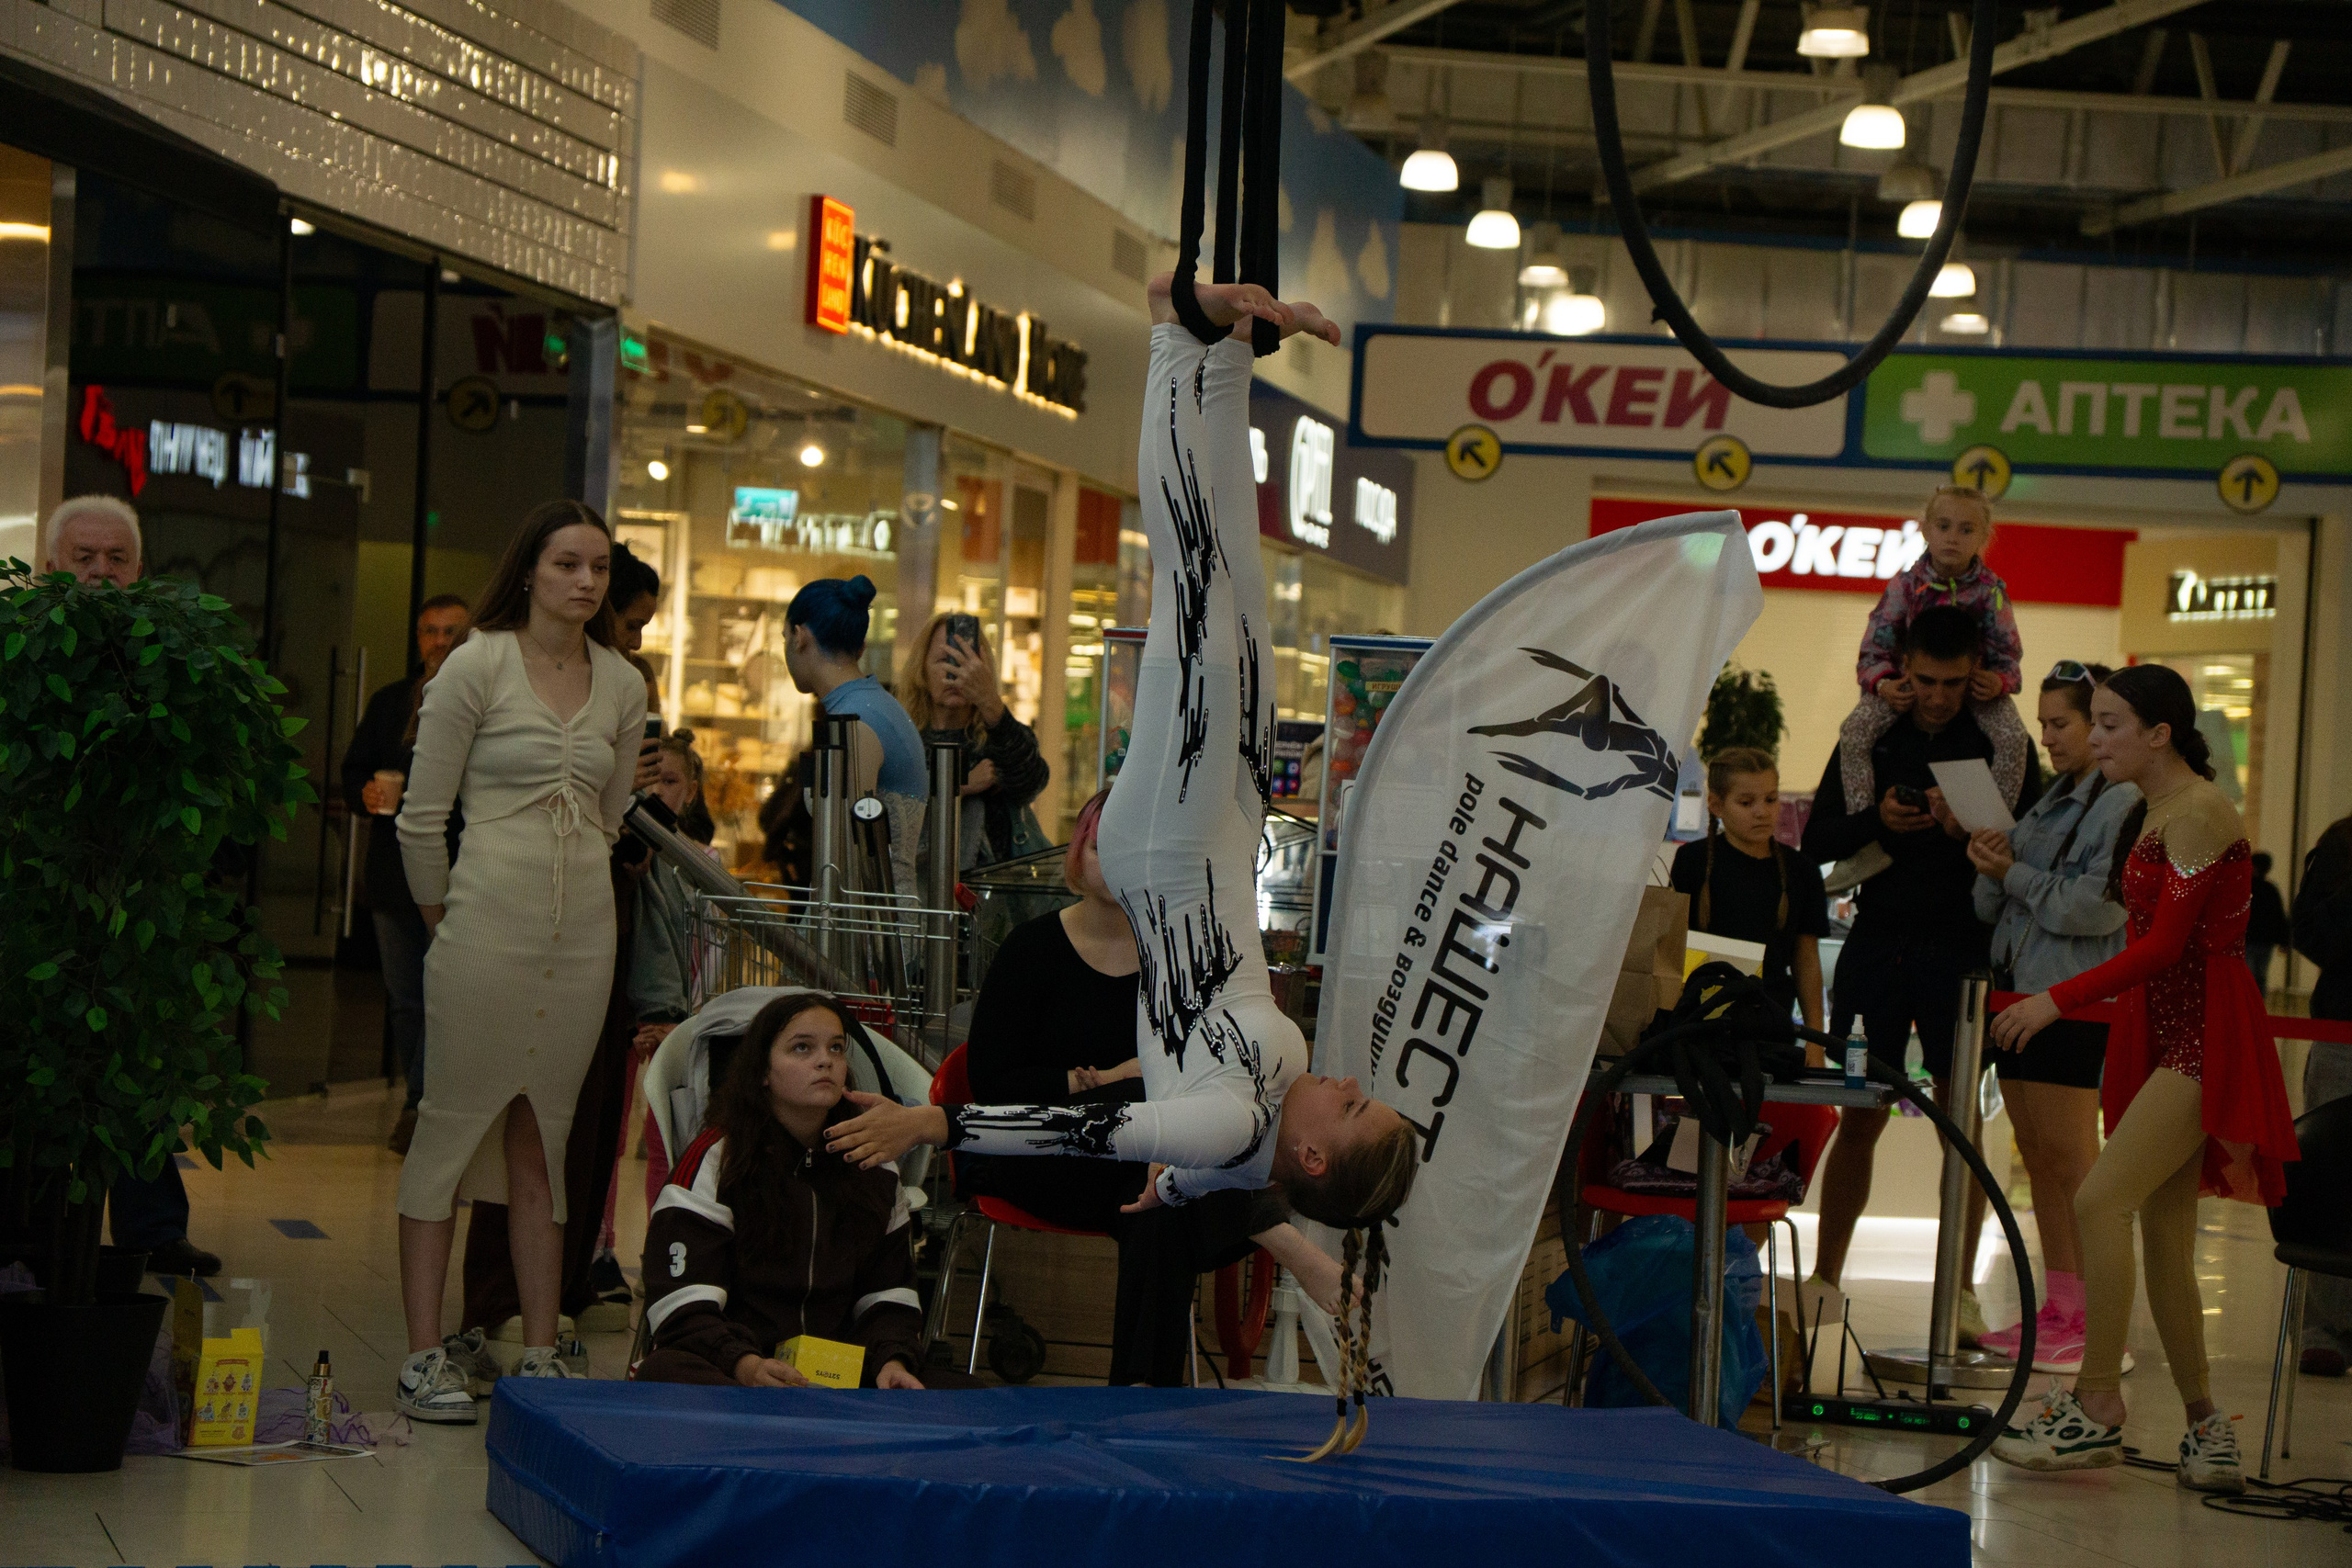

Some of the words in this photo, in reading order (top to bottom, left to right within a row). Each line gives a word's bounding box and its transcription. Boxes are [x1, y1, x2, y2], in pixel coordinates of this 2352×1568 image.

[1999, 379, 2312, 444] АПТЕКА
[1449, 773, 1485, 835] pole
[1414, 840, 1459, 922] dance
[1403, 926, 1427, 947] &
[1393, 795, 1548, 1164] НАШЕСТ
[669, 1241, 687, 1278] 3
